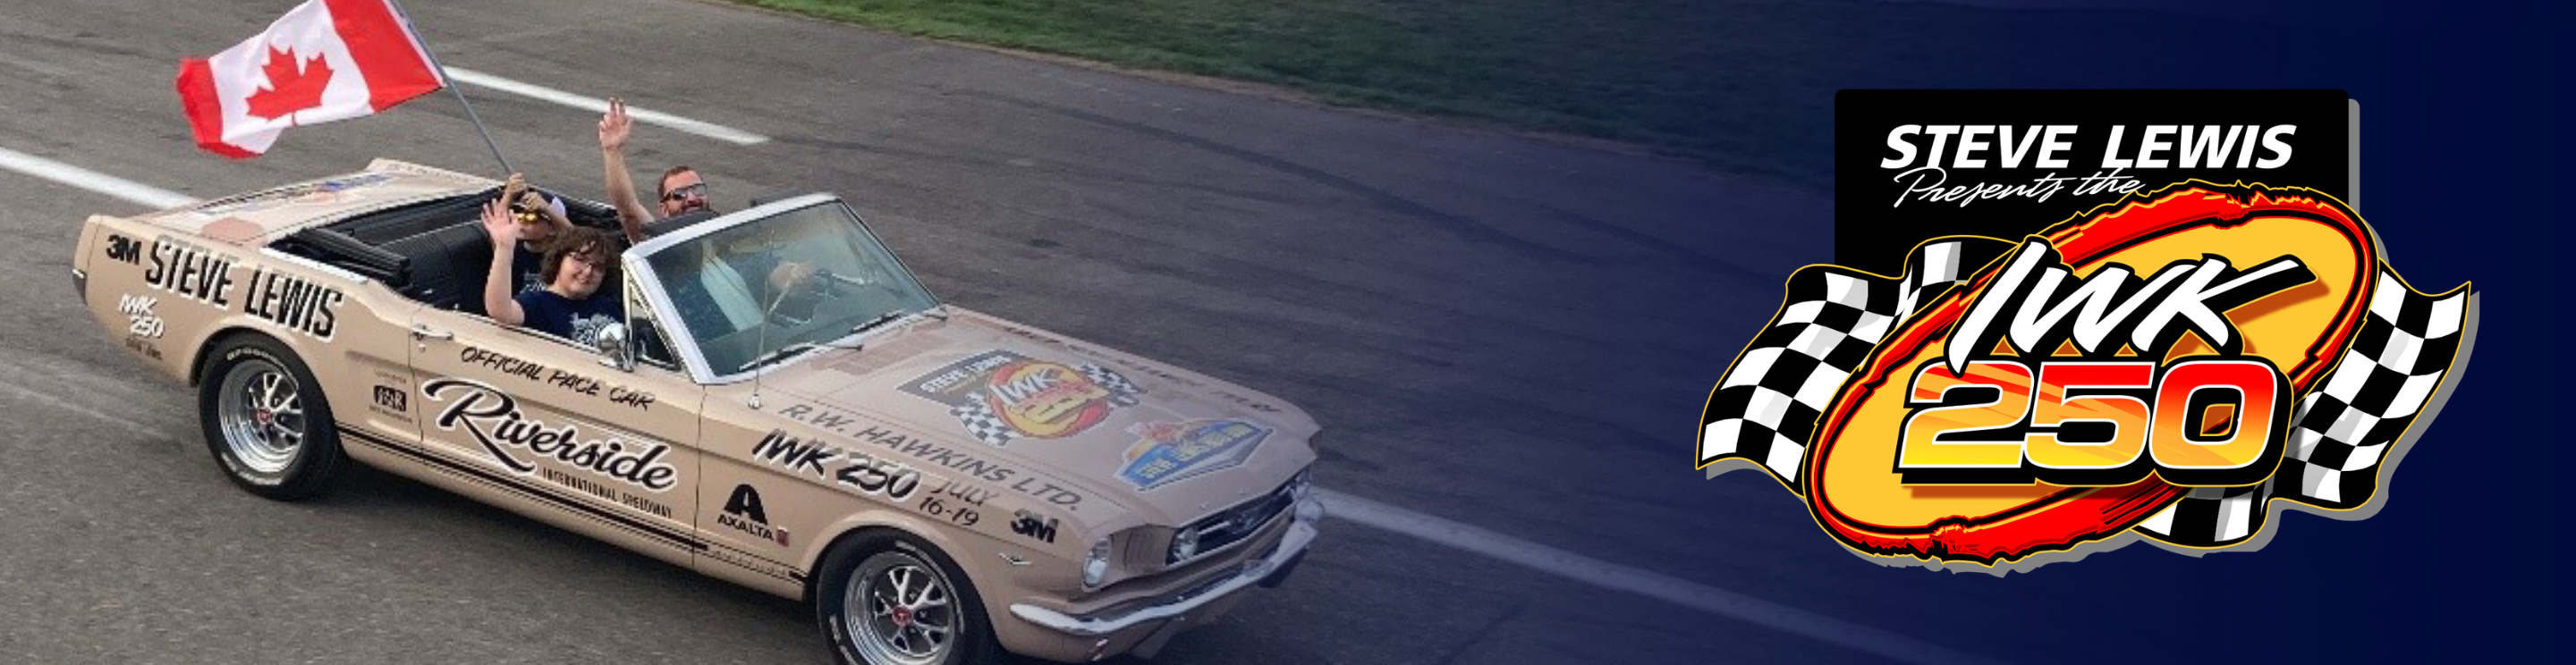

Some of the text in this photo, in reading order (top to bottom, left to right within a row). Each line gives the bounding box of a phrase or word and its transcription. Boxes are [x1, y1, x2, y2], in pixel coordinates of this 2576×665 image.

[106, 234, 141, 265] 3M
[118, 293, 157, 316] IWK
[145, 235, 343, 343] STEVE LEWIS
[131, 315, 165, 339] 250
[461, 346, 656, 411] OFFICIAL PACE CAR
[988, 367, 1057, 406] IWK
[422, 378, 678, 490] Riverside
[752, 429, 922, 502] IWK 250
[779, 404, 1082, 511] R. W. HAWKINS LTD.
[542, 466, 672, 519] INTERNATIONAL SPEEDWAY
[930, 480, 1000, 507] JULY
[717, 514, 775, 541] AXALTA
[919, 496, 979, 526] 16-19
[1010, 509, 1059, 543] 3M
